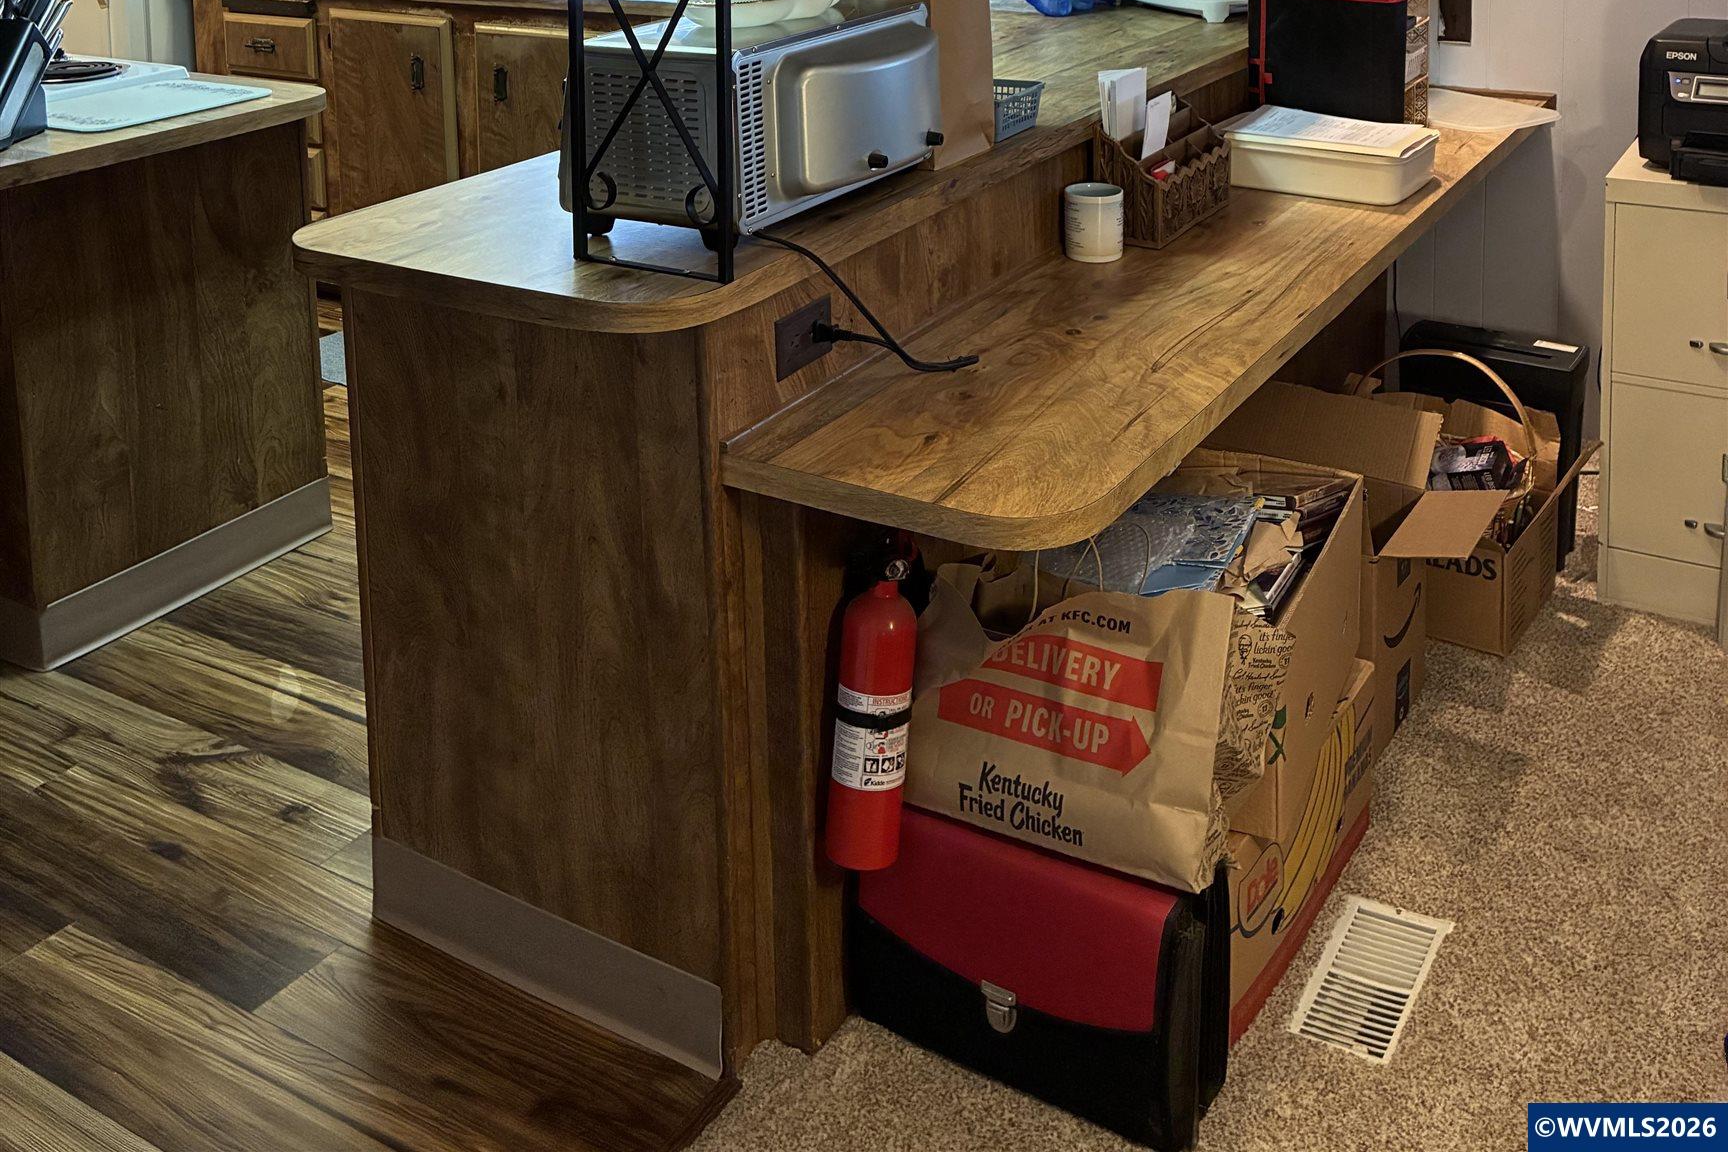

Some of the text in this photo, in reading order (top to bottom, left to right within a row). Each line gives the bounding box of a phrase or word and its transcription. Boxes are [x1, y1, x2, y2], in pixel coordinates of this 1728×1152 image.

[1666, 51, 1697, 61] EPSON
[1060, 610, 1131, 634] KFC.COM
[1247, 682, 1273, 695] finger
[969, 692, 1110, 753] OR PICK-UP
[870, 778, 885, 786] Kidde
[979, 761, 1064, 818] Kentucky
[958, 782, 1083, 847] Fried Chicken
[1246, 856, 1279, 915] Dole
